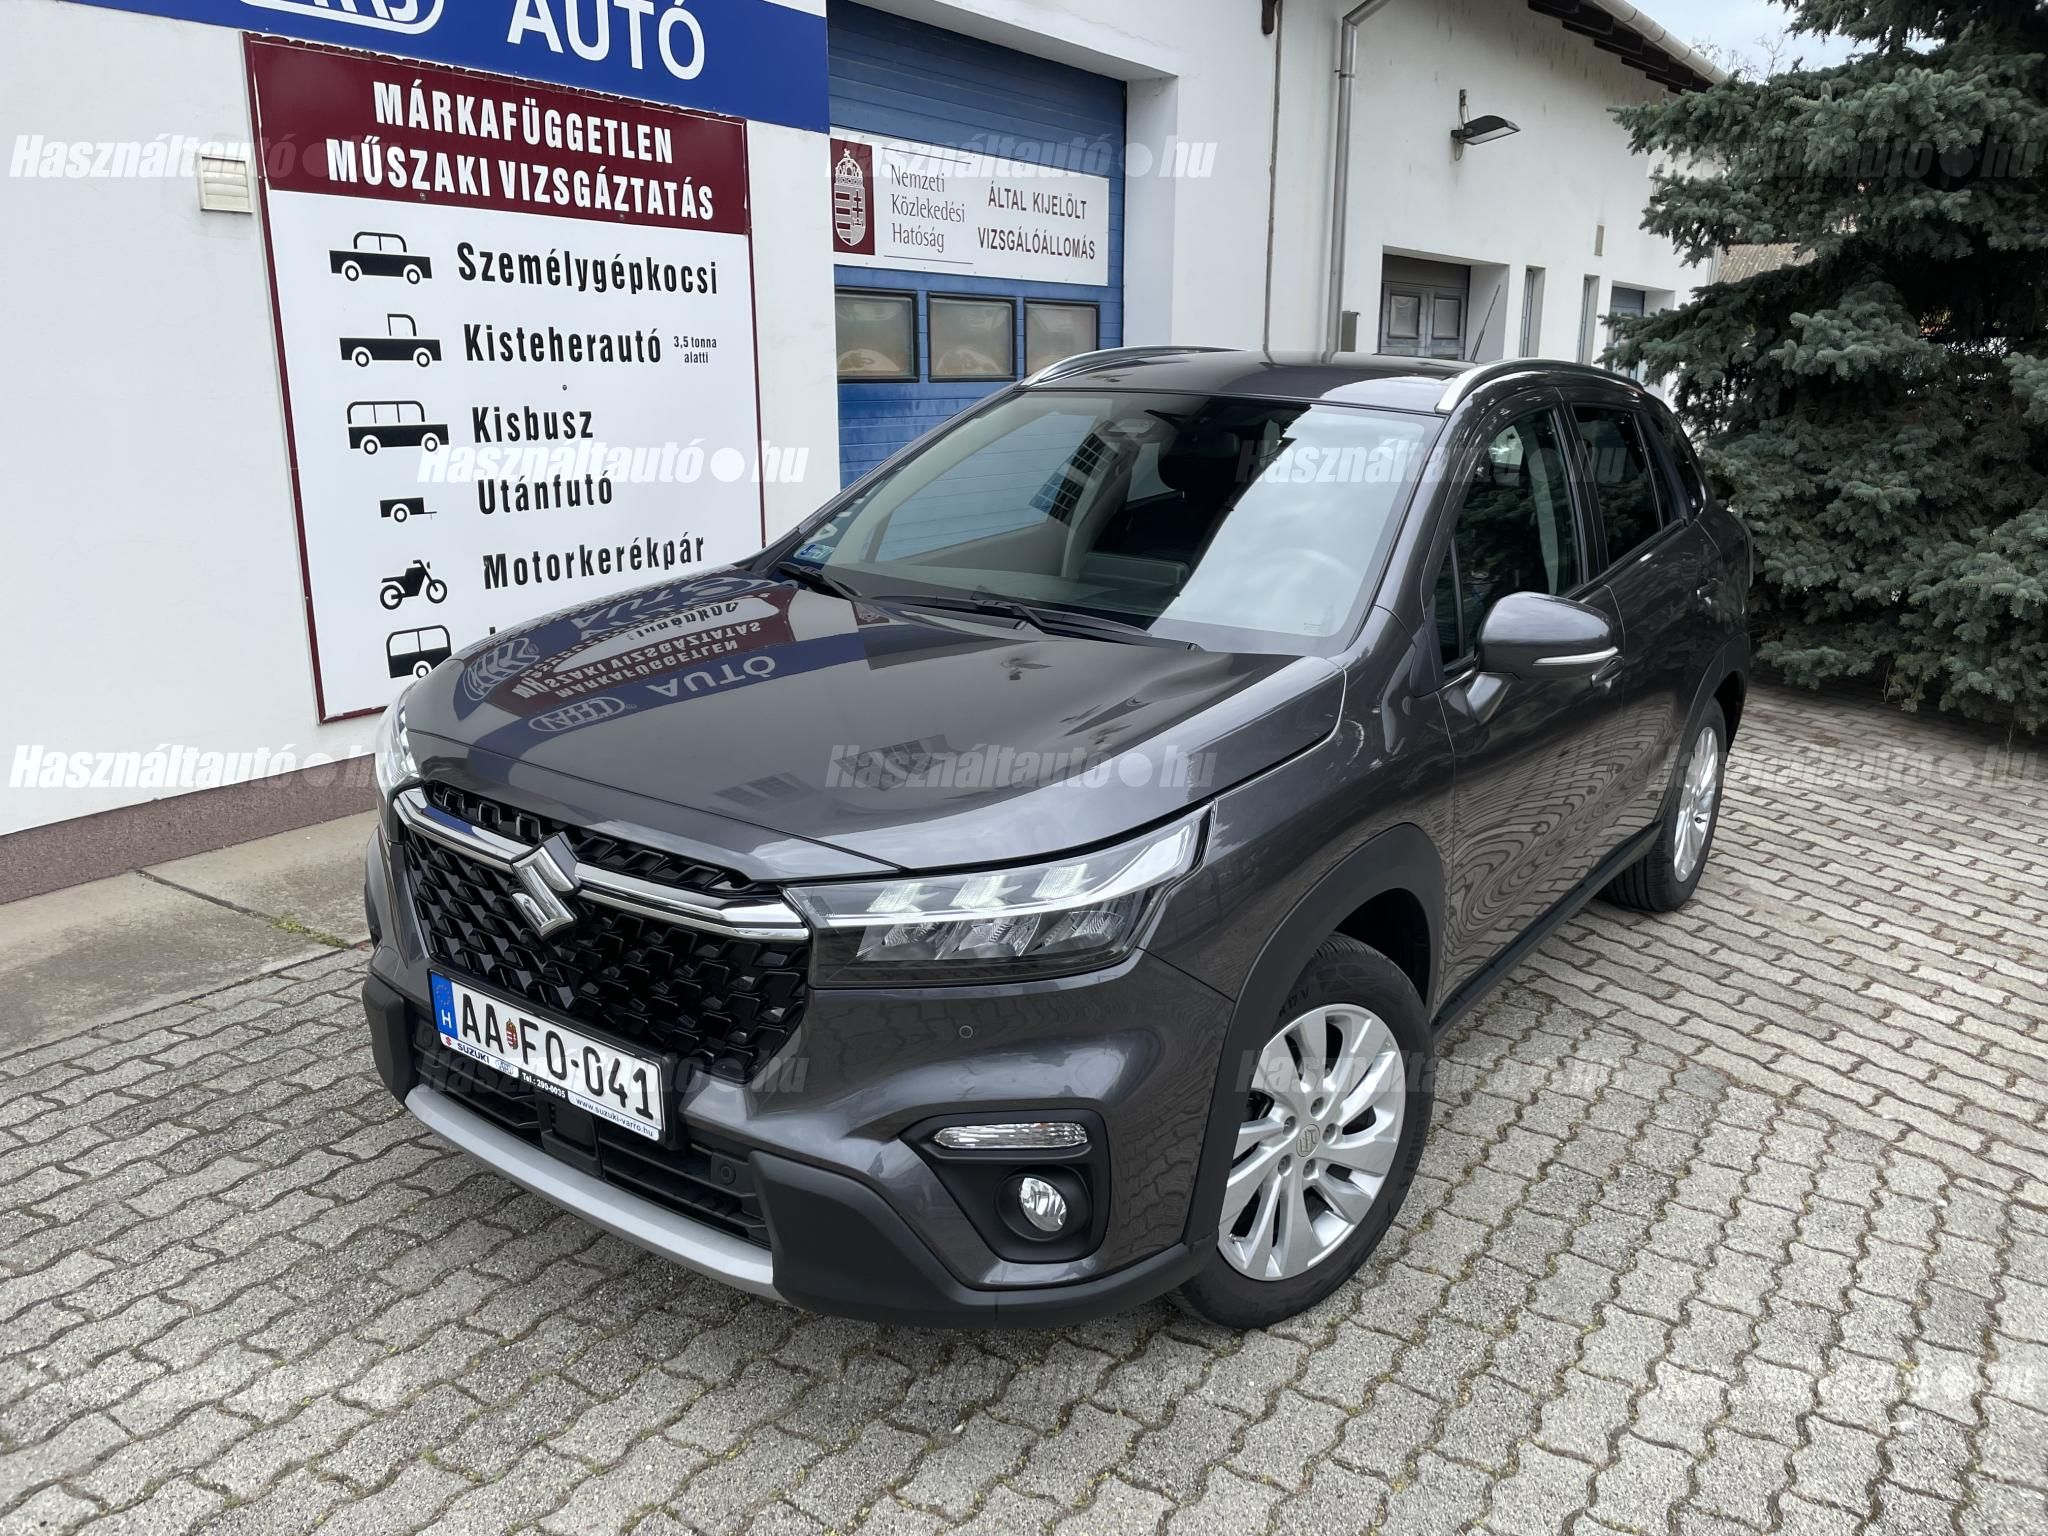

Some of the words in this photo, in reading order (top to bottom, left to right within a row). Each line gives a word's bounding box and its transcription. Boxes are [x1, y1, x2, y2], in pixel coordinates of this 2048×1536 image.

[507, 0, 705, 80] AUTÓ
[374, 79, 673, 164] MÁRKAFÜGGETLEN
[325, 135, 491, 196] MŰSZAKI
[498, 160, 714, 220] VIZSGÁZTATÁS
[889, 164, 945, 193] Nemzeti
[891, 194, 965, 223] Közlekedési
[988, 181, 1027, 211] ÁLTAL
[1033, 192, 1087, 220] KIJELÖLT
[892, 223, 945, 253] Hatóság
[977, 226, 1096, 260] VIZSGÁLÓÁLLOMÁS
[457, 242, 717, 294] Személygépkocsi
[464, 324, 661, 363] Kisteherautó
[674, 336, 689, 349] 3,5
[691, 337, 717, 349] tonna
[684, 351, 709, 364] alatti
[473, 406, 594, 443] Kisbusz
[478, 470, 613, 515] Utánfutó
[483, 532, 704, 590] Motorkerékpár
[441, 1009, 452, 1029] H
[462, 993, 504, 1054] AA
[457, 1042, 490, 1064] SUZUKI
[521, 1071, 537, 1085] Tel.:
[575, 1097, 654, 1137] www.suzuki-varro.hu
